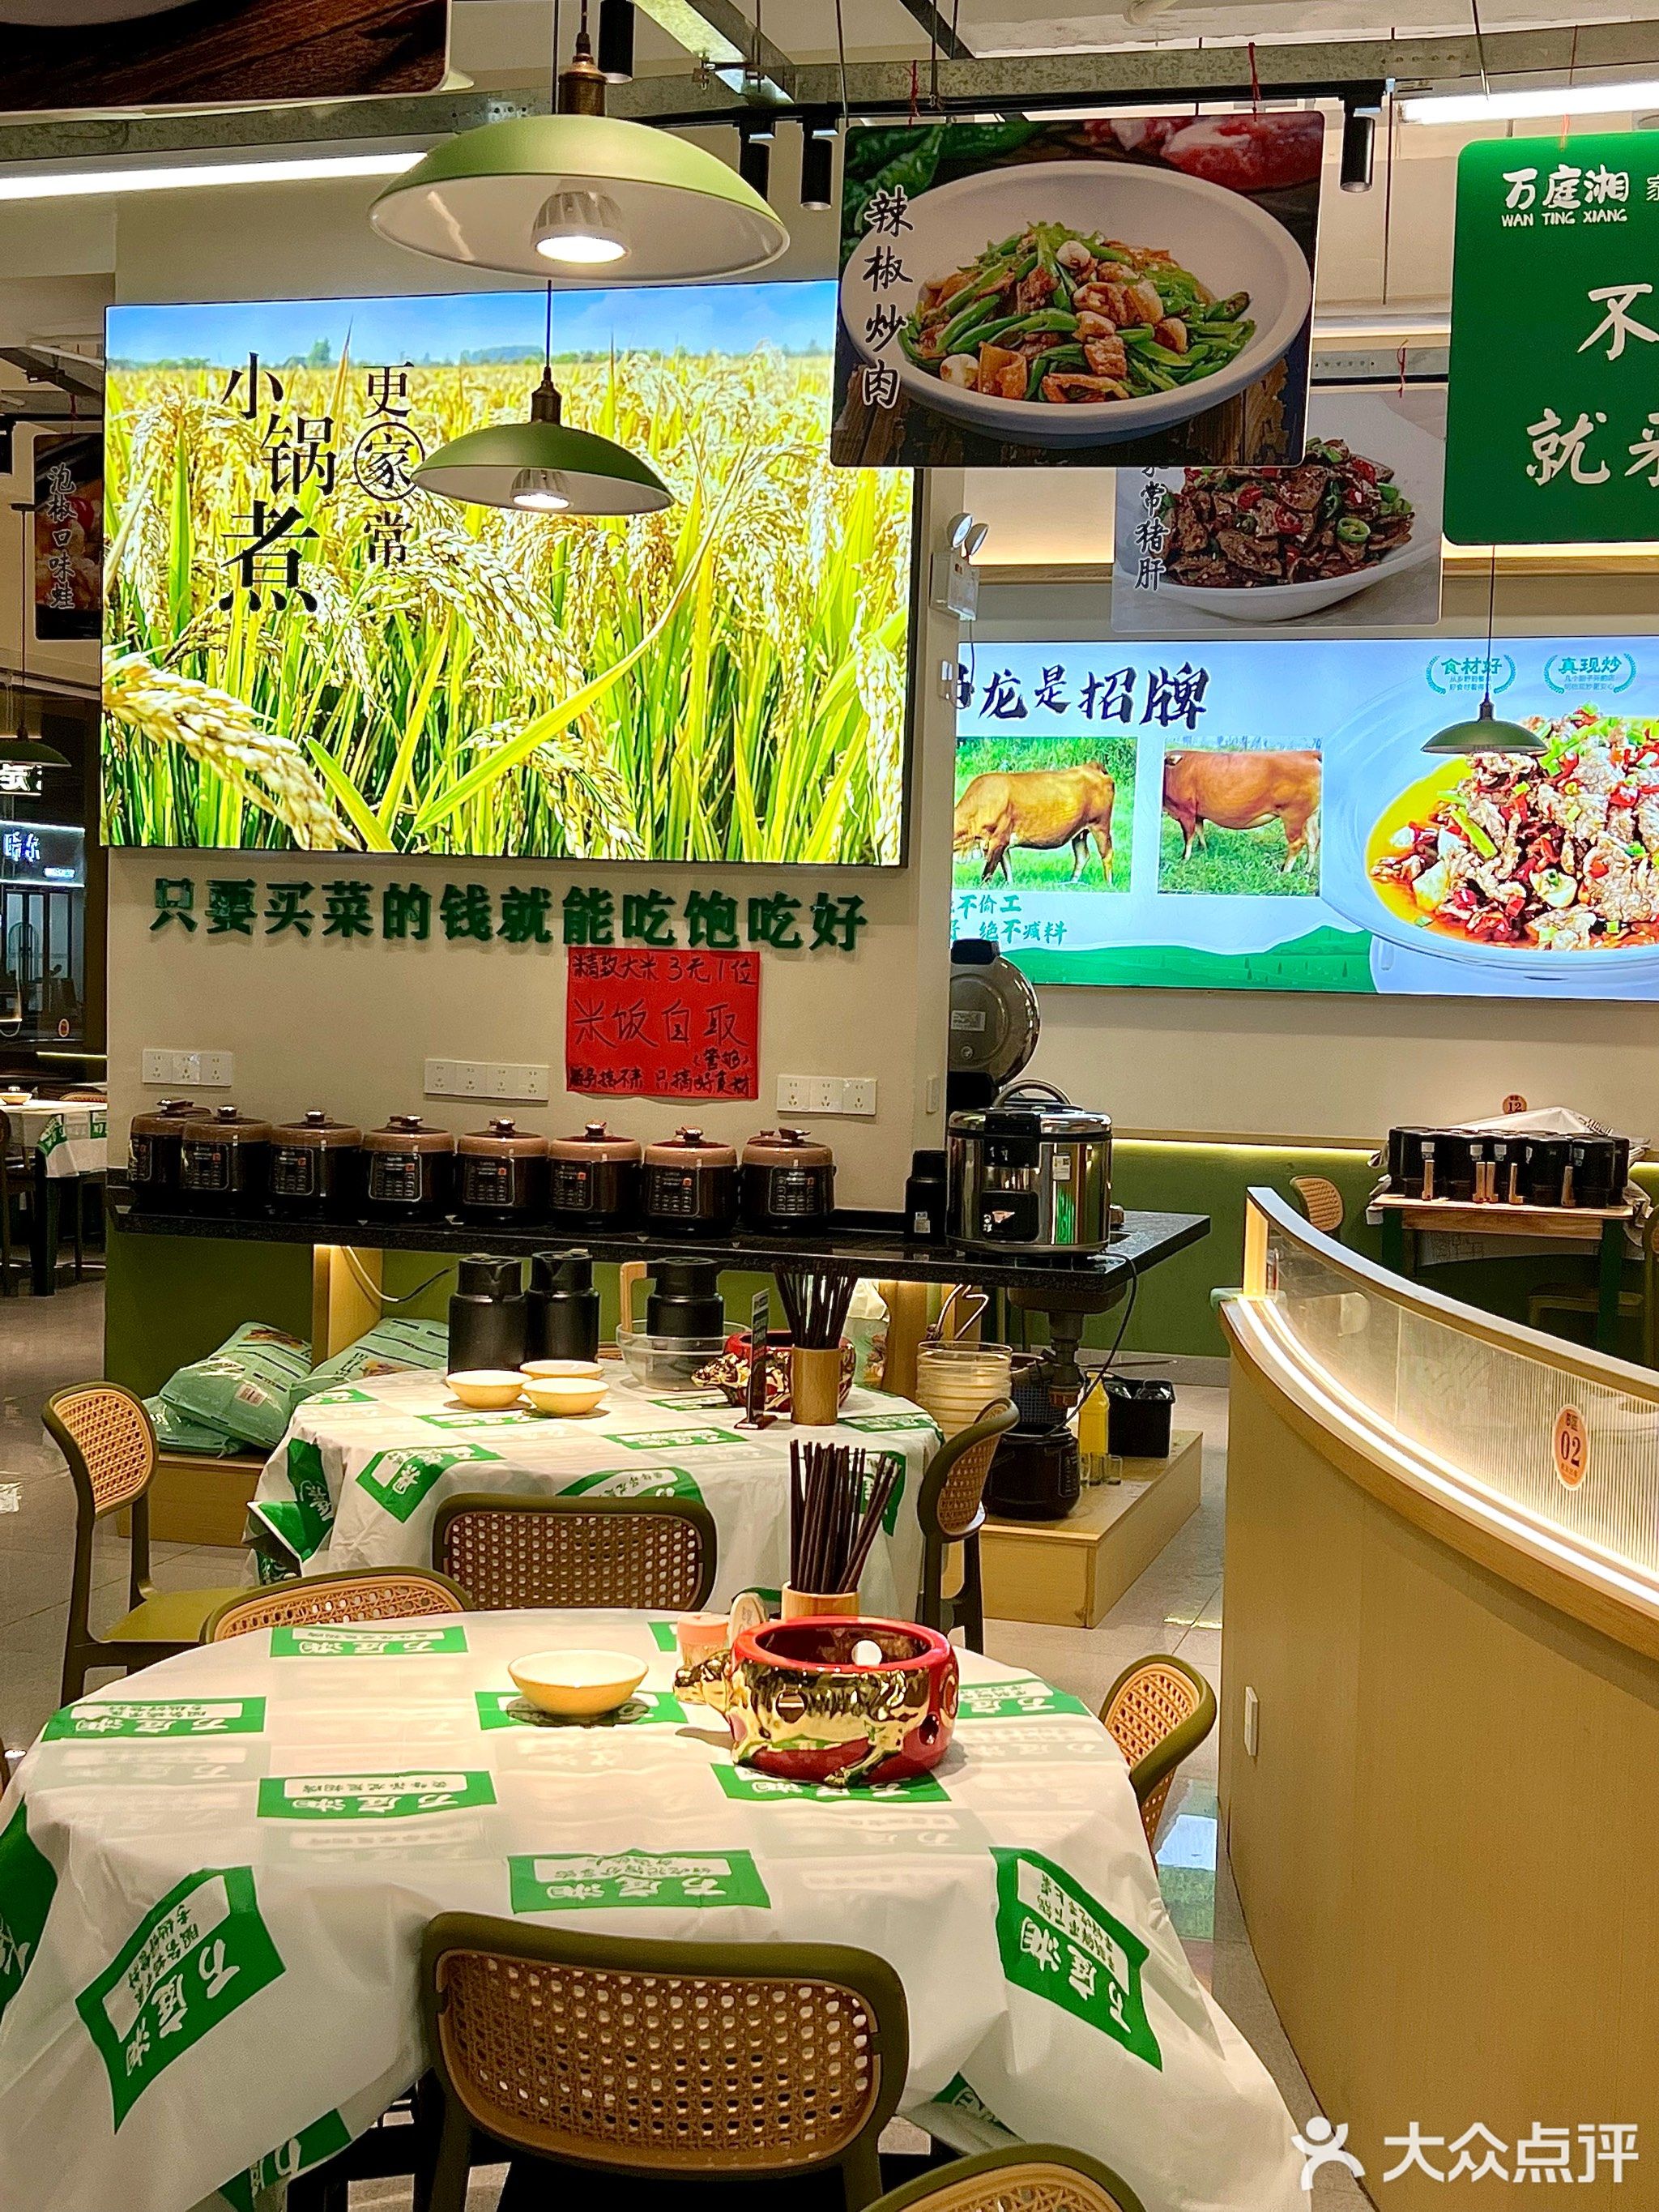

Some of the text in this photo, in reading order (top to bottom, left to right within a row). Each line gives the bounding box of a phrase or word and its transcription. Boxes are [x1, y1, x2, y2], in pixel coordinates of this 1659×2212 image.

[1503, 164, 1629, 211] 万庭湘
[1501, 209, 1627, 227] WAN TING XIANG
[862, 185, 913, 408] 辣椒炒肉
[1577, 284, 1659, 361] 不
[220, 352, 335, 613] 小锅煮
[362, 361, 416, 568] 更家常
[47, 462, 78, 609] 泡椒口味蛙
[1441, 657, 1503, 675] 食材好
[1559, 656, 1621, 673] 真现炒
[149, 877, 868, 951] 只要买菜的钱就能吃饱吃好
[952, 895, 1021, 920] 不偷工
[574, 997, 749, 1048] 米饭自取
[1561, 1431, 1580, 1467] 02
[75, 1717, 229, 1734] 万庭湘
[970, 1697, 1055, 1714] 万庭
[292, 1794, 458, 1813] 万庭湘
[546, 1876, 727, 1900] 万庭湘
[1021, 1916, 1132, 2034] 万庭湘
[126, 1938, 240, 2076] 万庭湘
